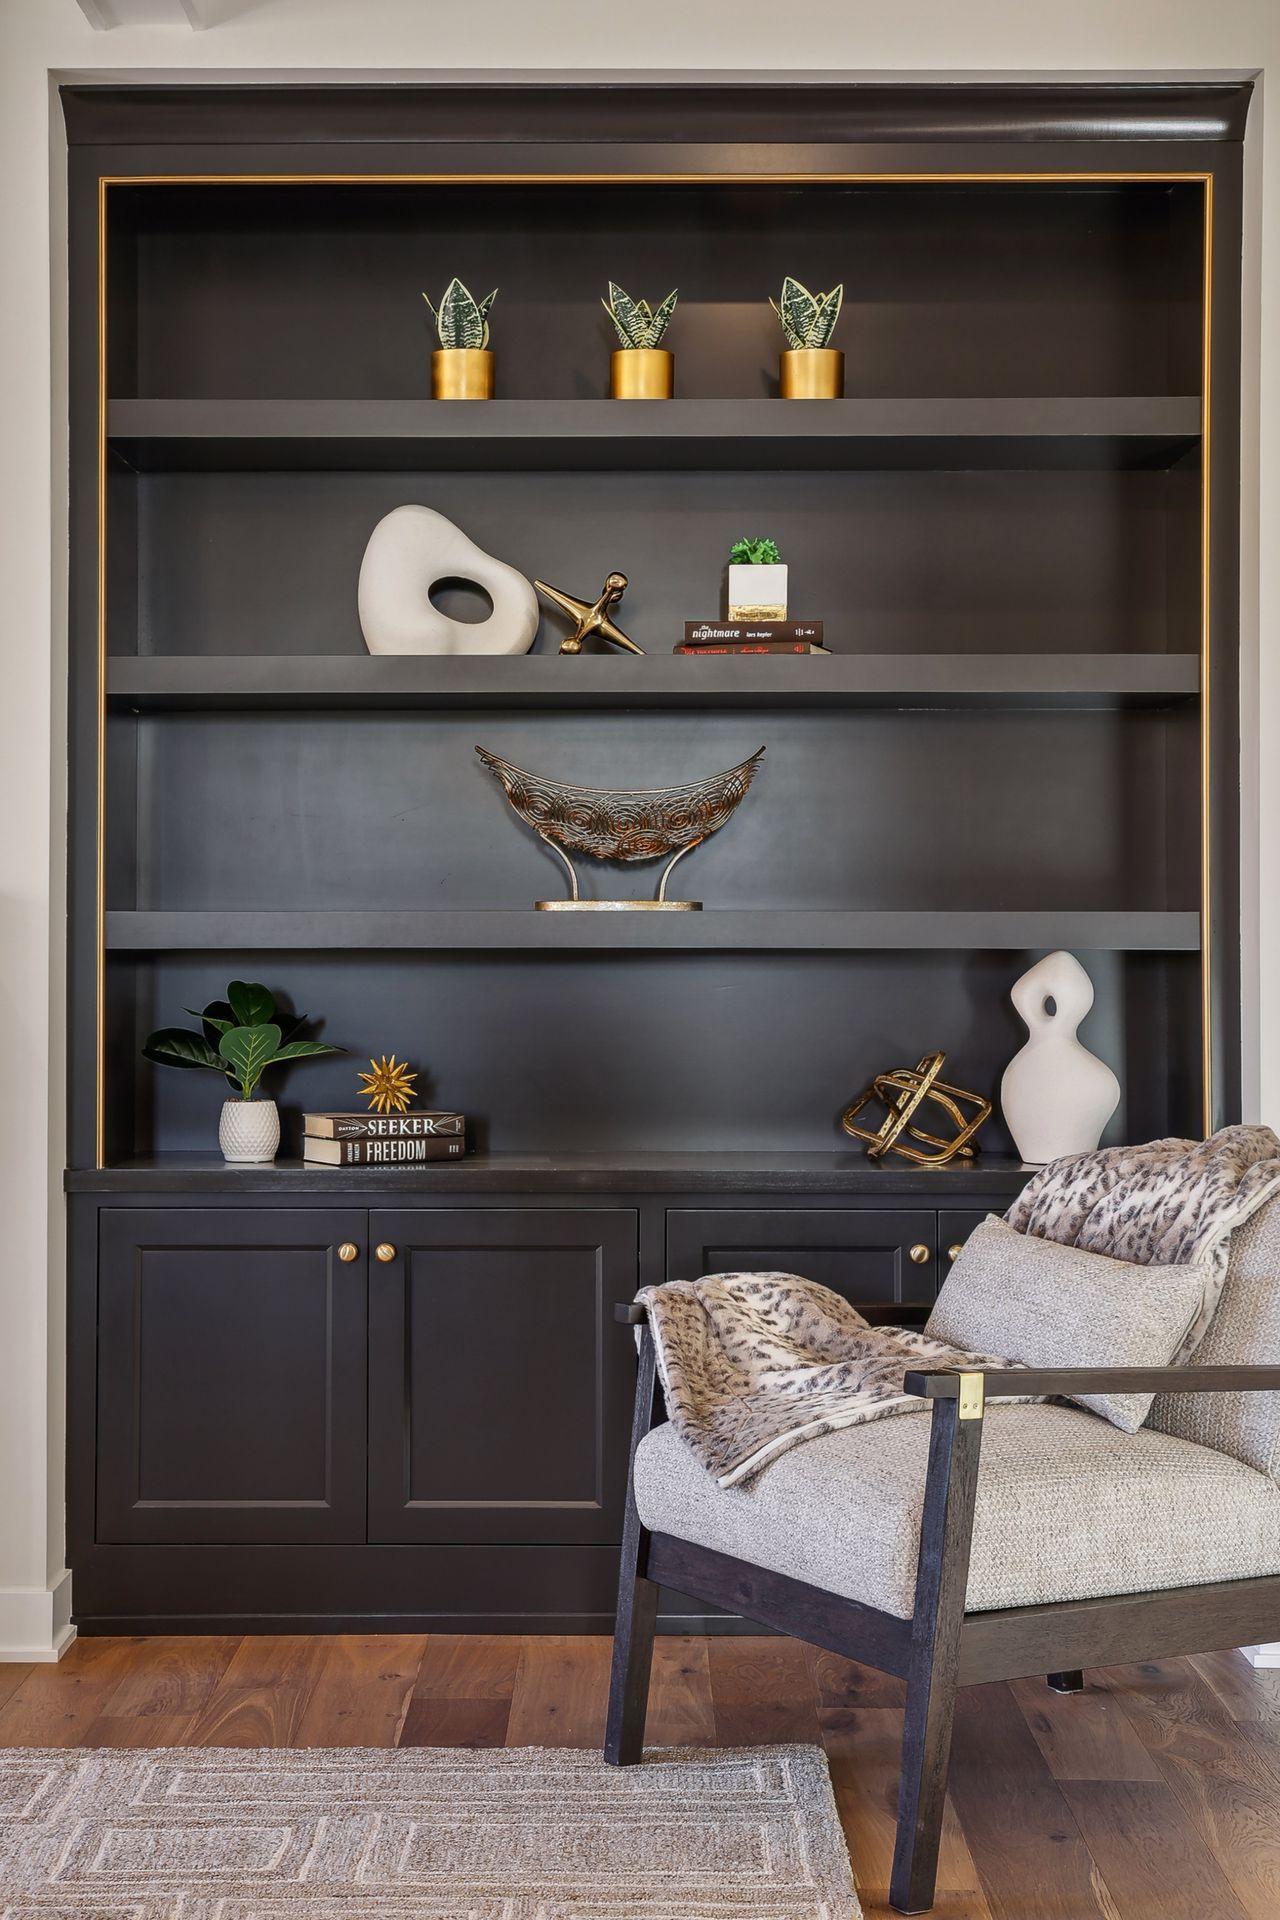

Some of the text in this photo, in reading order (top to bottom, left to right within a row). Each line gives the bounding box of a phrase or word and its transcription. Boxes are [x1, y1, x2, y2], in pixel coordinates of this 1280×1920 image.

[692, 628, 740, 640] nightmare
[367, 1118, 437, 1136] SEEKER
[366, 1140, 426, 1162] FREEDOM
